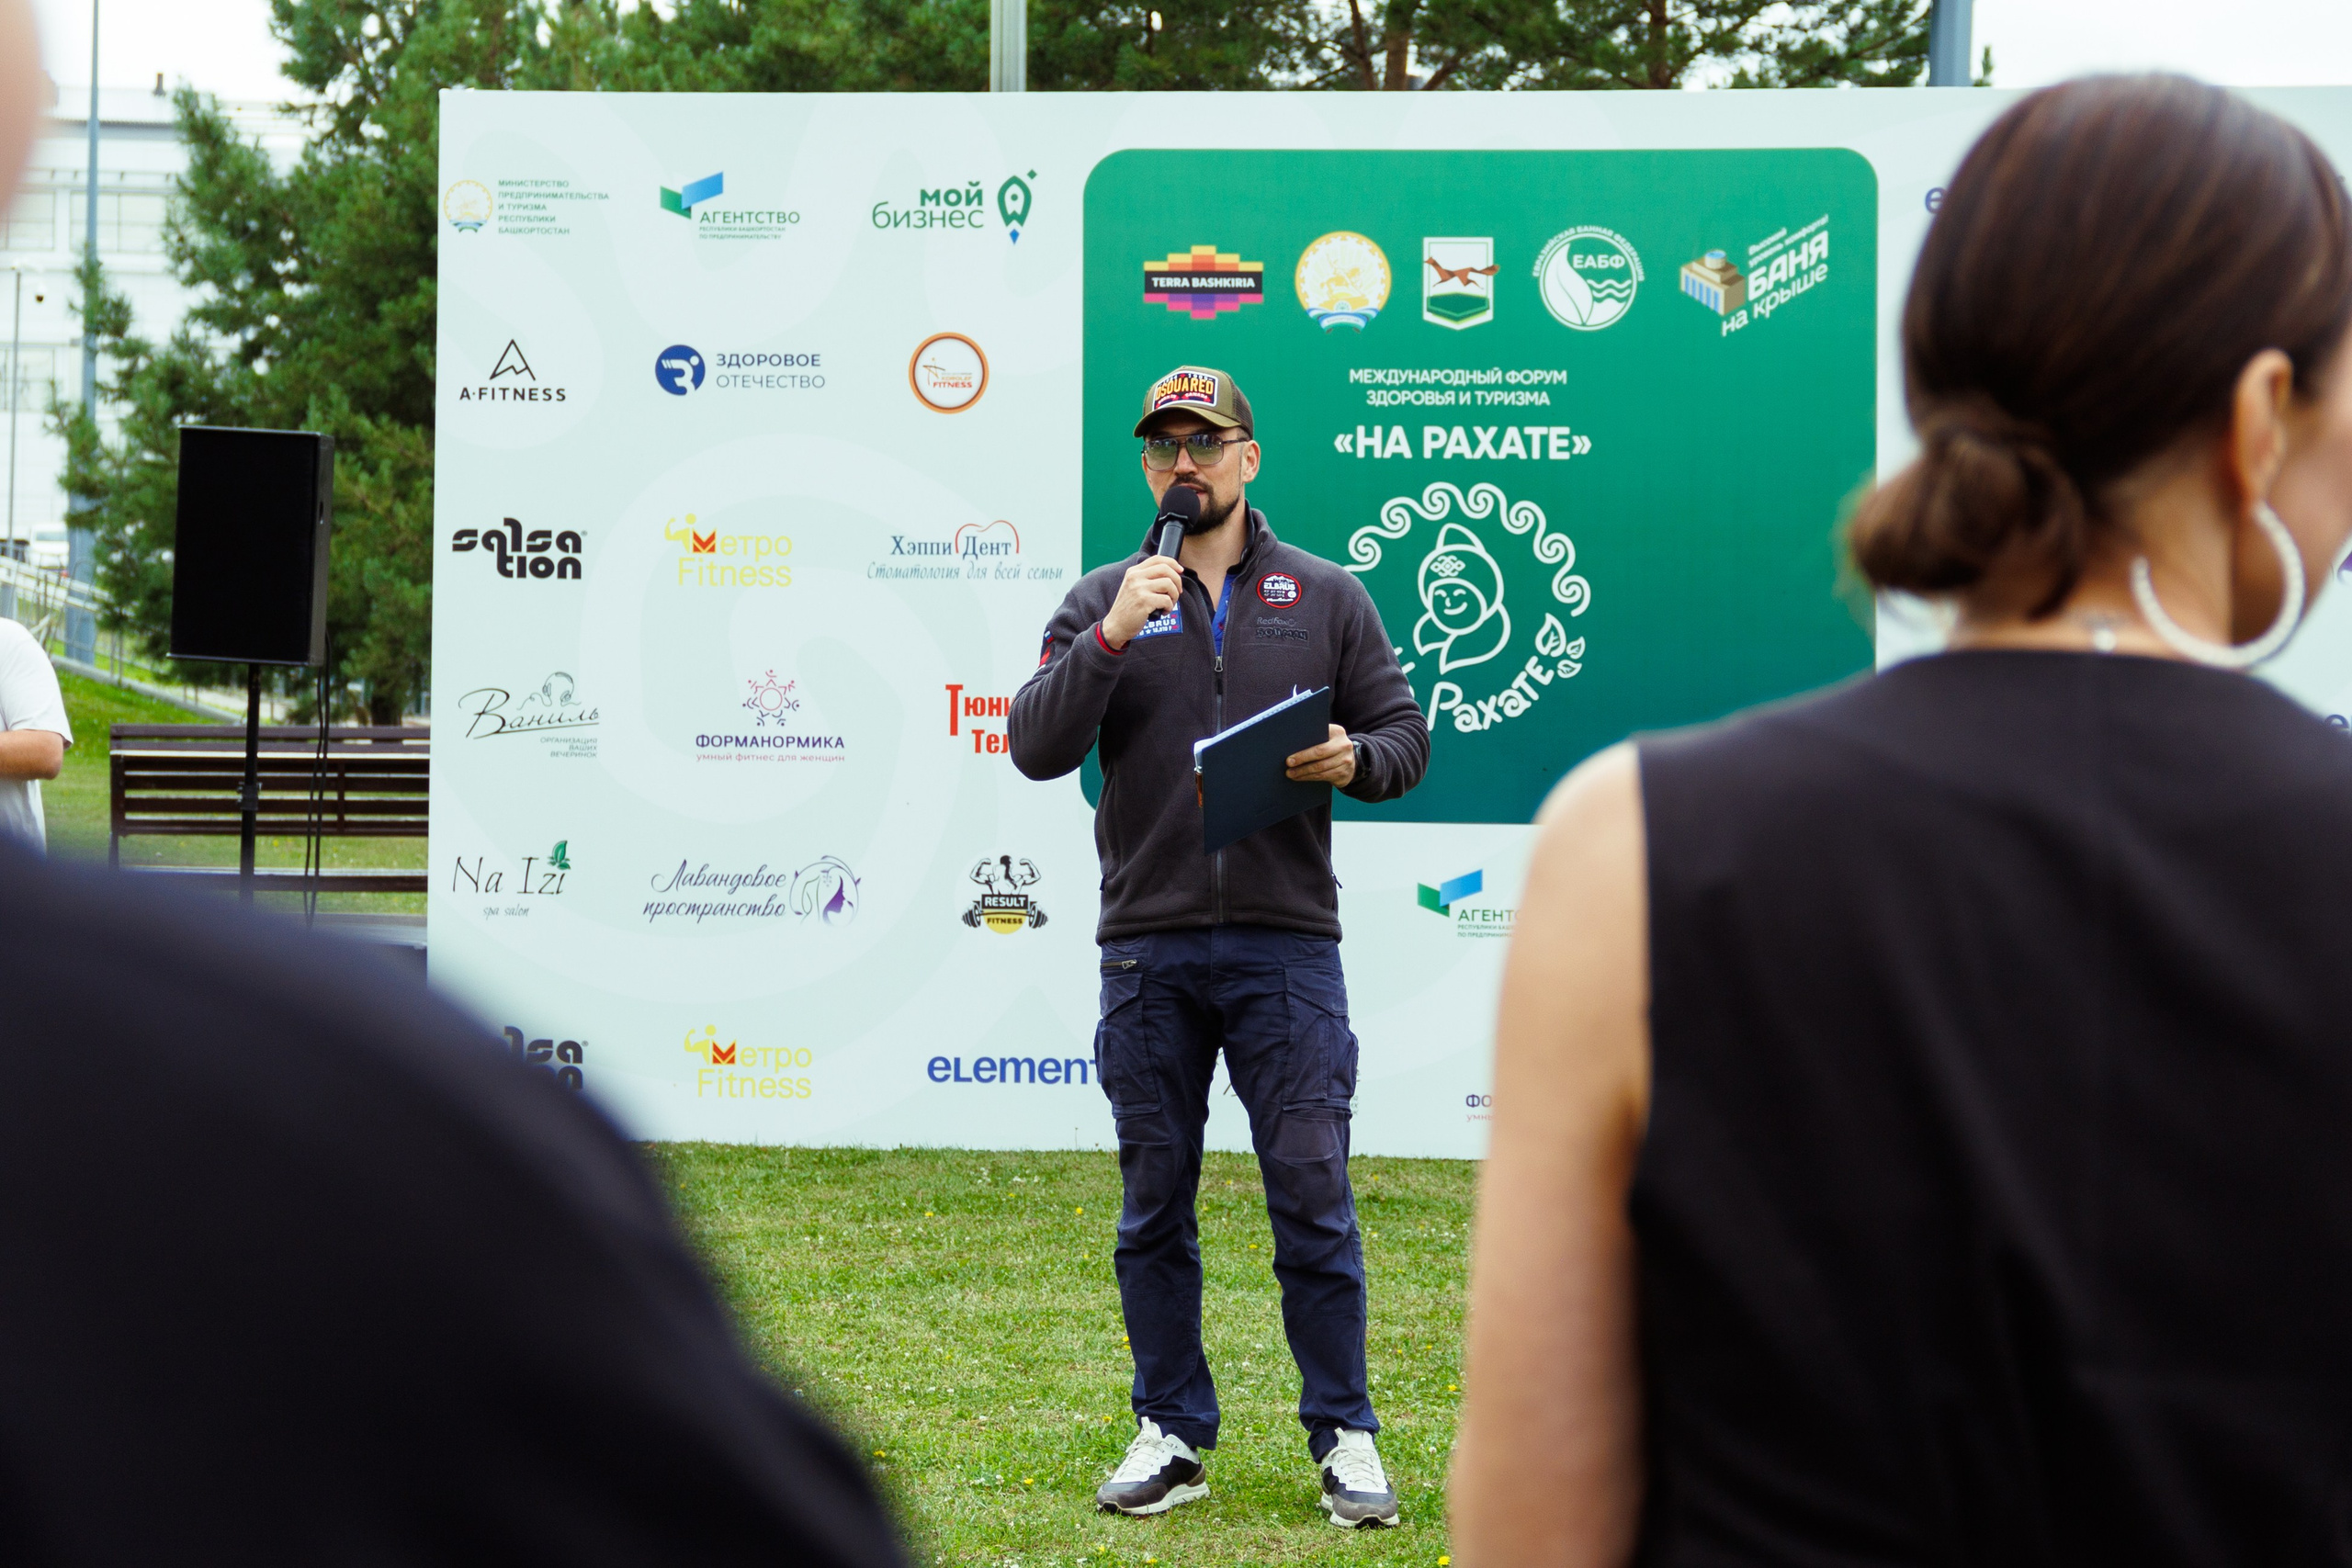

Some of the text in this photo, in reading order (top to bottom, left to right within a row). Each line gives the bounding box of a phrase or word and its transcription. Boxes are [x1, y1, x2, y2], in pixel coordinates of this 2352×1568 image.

[498, 191, 609, 200] ПРЕДПРИНИМАТЕЛЬСТВА
[920, 181, 983, 207] мой
[498, 215, 556, 223] РЕСПУБЛИКИ
[699, 211, 800, 224] АГЕНТСТВО
[872, 201, 984, 229] бизнес
[498, 227, 571, 235] БАШКОРТОСТАН
[1572, 254, 1626, 269] ЕАБФ
[1747, 231, 1829, 301] БАНЯ
[1151, 277, 1256, 288] TERRA BASHKIRIA
[1722, 264, 1828, 337] на крыше
[716, 354, 821, 368] ЗДОРОВОЕ
[716, 375, 826, 389] ОТЕЧЕСТВО
[1349, 367, 1567, 386] МЕЖДУНАРОДНЫЙ ФОРУМ
[1366, 390, 1551, 407] ЗДОРОВЬЯ И ТУРИЗМА
[1333, 425, 1592, 460] «НА РАХАТЕ»
[452, 517, 582, 553] salsa
[692, 527, 793, 562] Метро
[889, 536, 1012, 560] Хэппи Дент
[678, 557, 792, 587] Fitness
[867, 560, 1064, 580] Стоматология для всей семьи
[1143, 618, 1177, 629] LBRUS
[458, 688, 600, 739] Ваниль
[540, 737, 598, 745] ОРГАНИЗАЦИЯ
[695, 734, 845, 749] ФОРМАНОРМИКА
[696, 753, 732, 762] умный
[735, 753, 775, 762] фитнес
[799, 754, 845, 762] женщин
[452, 856, 503, 894] Na
[650, 859, 786, 895] Лавандовое
[483, 904, 530, 920] spa salon
[642, 894, 786, 924] пространство
[984, 897, 1026, 908] RESULT
[712, 1039, 812, 1074] Метро
[927, 1056, 1096, 1085] eLemen
[697, 1068, 812, 1099] Fitness
